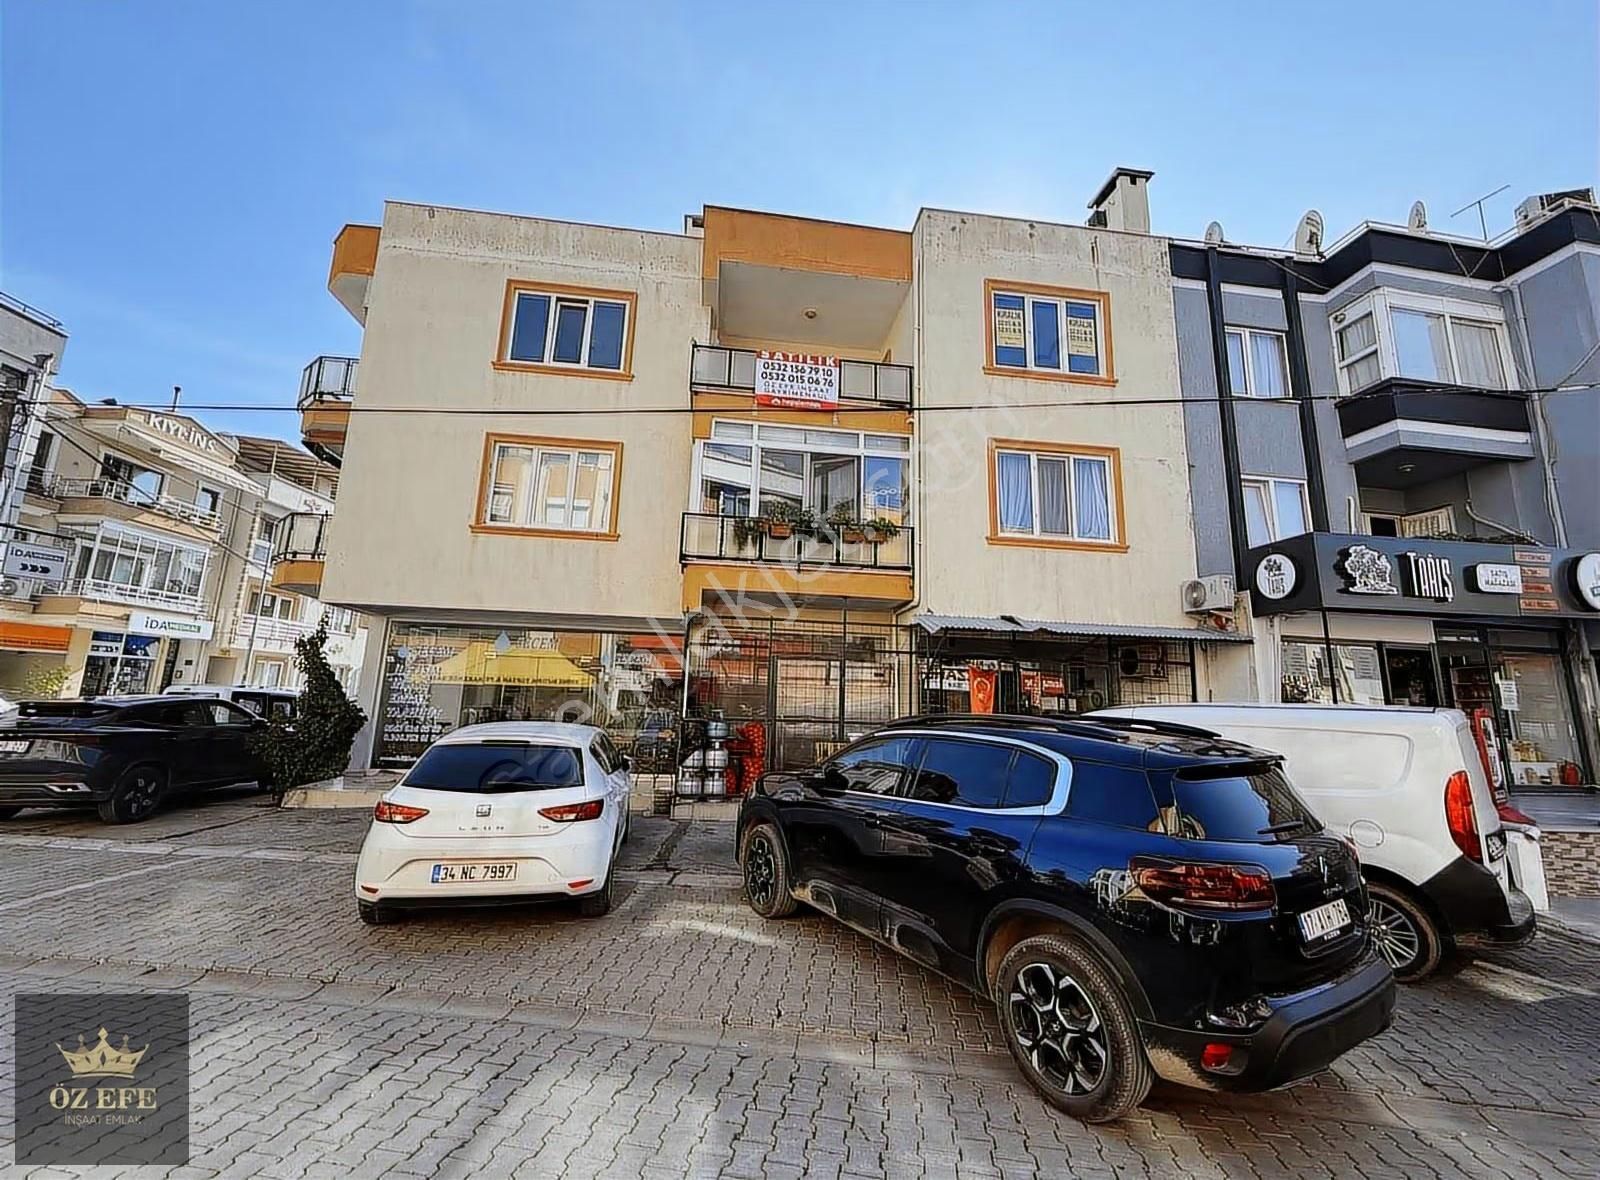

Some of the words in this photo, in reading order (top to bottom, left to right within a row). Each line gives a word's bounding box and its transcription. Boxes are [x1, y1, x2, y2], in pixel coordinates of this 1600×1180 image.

[761, 350, 836, 366] SATILIK
[763, 361, 788, 373] 0532
[790, 364, 807, 375] 156
[807, 366, 820, 376] 79
[822, 368, 833, 378] 10
[761, 371, 786, 382] 0532
[788, 374, 806, 384] 015
[807, 376, 820, 386] 06
[823, 378, 834, 388] 76
[441, 864, 455, 880] 34
[460, 864, 476, 880] NC
[483, 864, 513, 879] 7997
